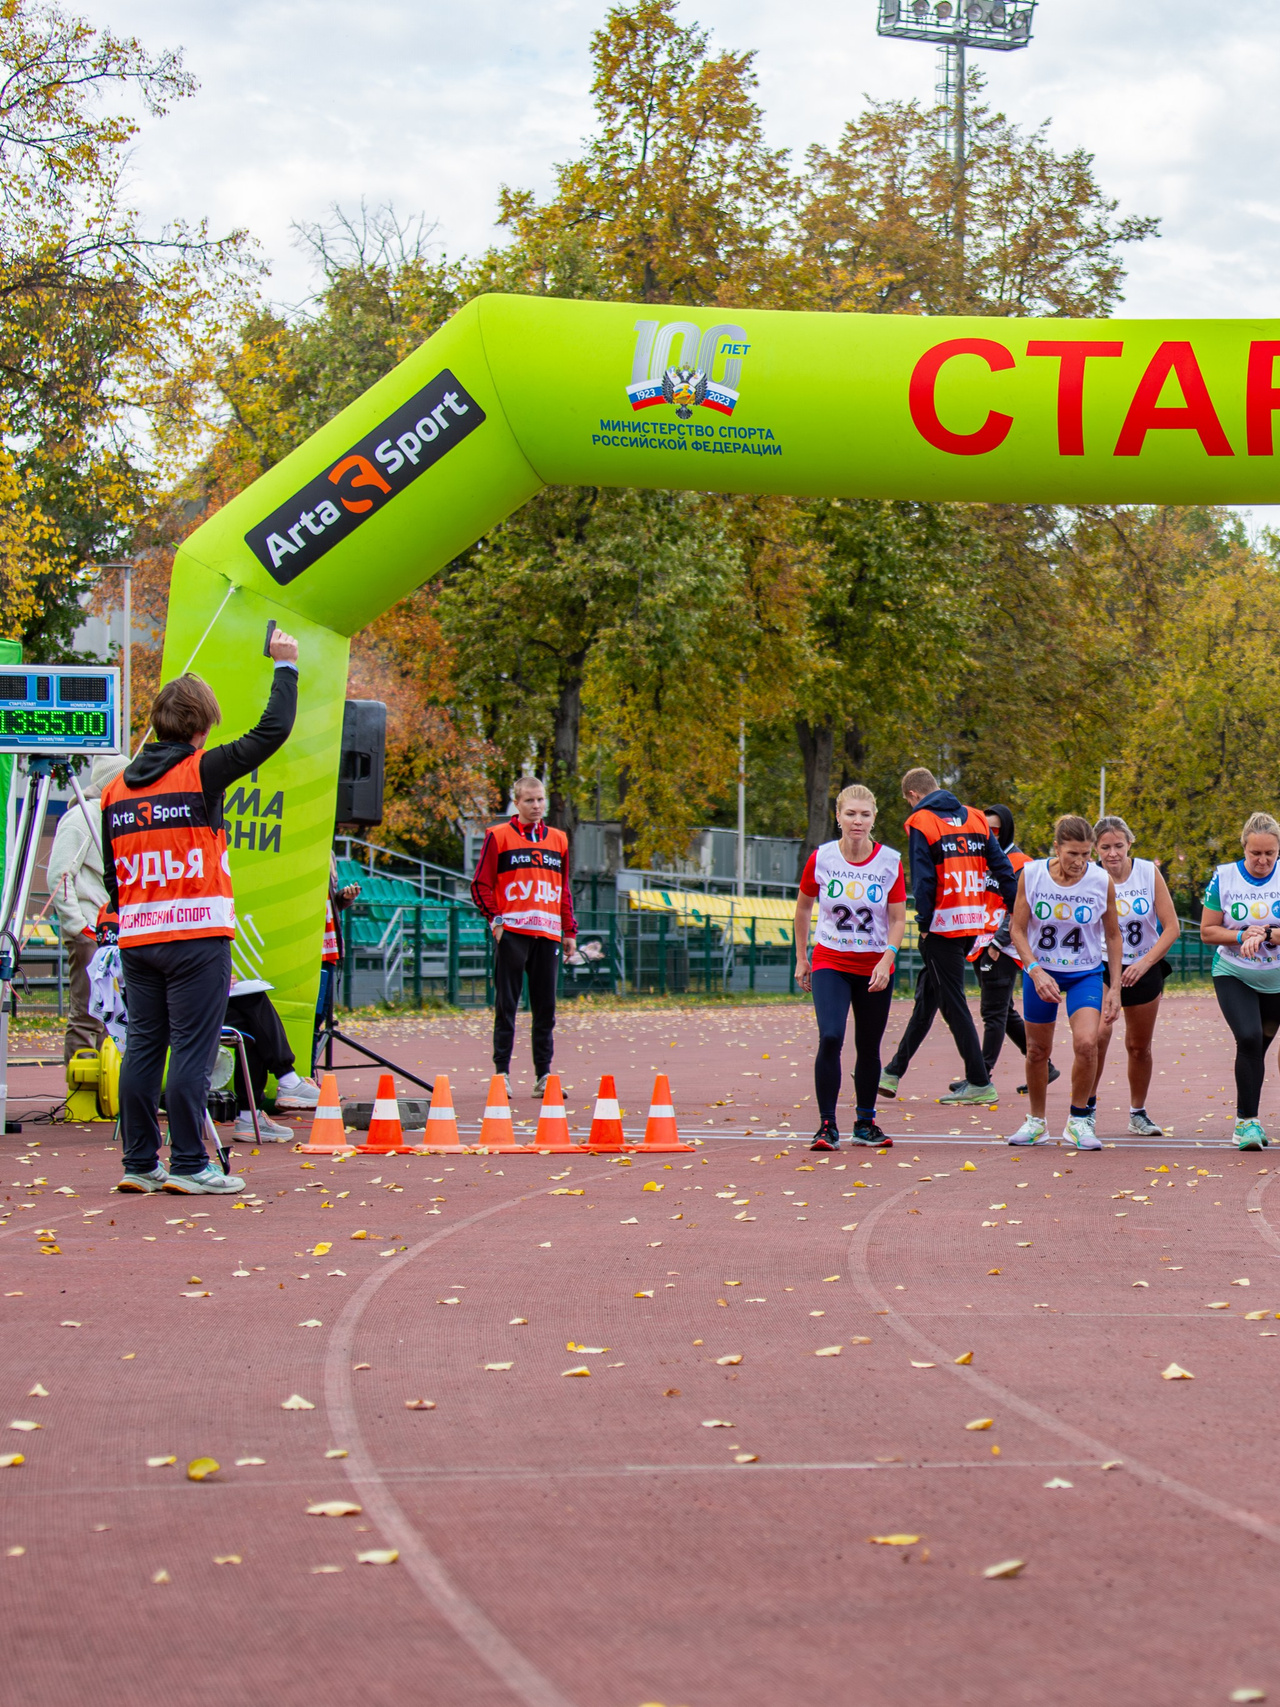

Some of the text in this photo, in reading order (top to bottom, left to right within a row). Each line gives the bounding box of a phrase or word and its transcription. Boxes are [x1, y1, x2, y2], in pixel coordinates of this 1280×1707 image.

[720, 343, 751, 355] ЛЕТ
[635, 388, 656, 401] 1923
[708, 391, 731, 407] 2023
[600, 419, 775, 440] МИНИСТЕРСТВО СПОРТА
[592, 434, 783, 456] РОССИЙСКОЙ ФЕДЕРАЦИИ
[266, 391, 470, 568] Arta Sport
[112, 804, 191, 828] Arta Sport
[827, 870, 887, 884] VMARAFONE
[943, 870, 986, 897] СУДЬ
[1035, 892, 1095, 904] VMARAFONE
[176, 906, 212, 923] СПОРТ
[832, 904, 873, 935] 22
[1038, 924, 1084, 954] 84
[1119, 921, 1144, 948] 8
